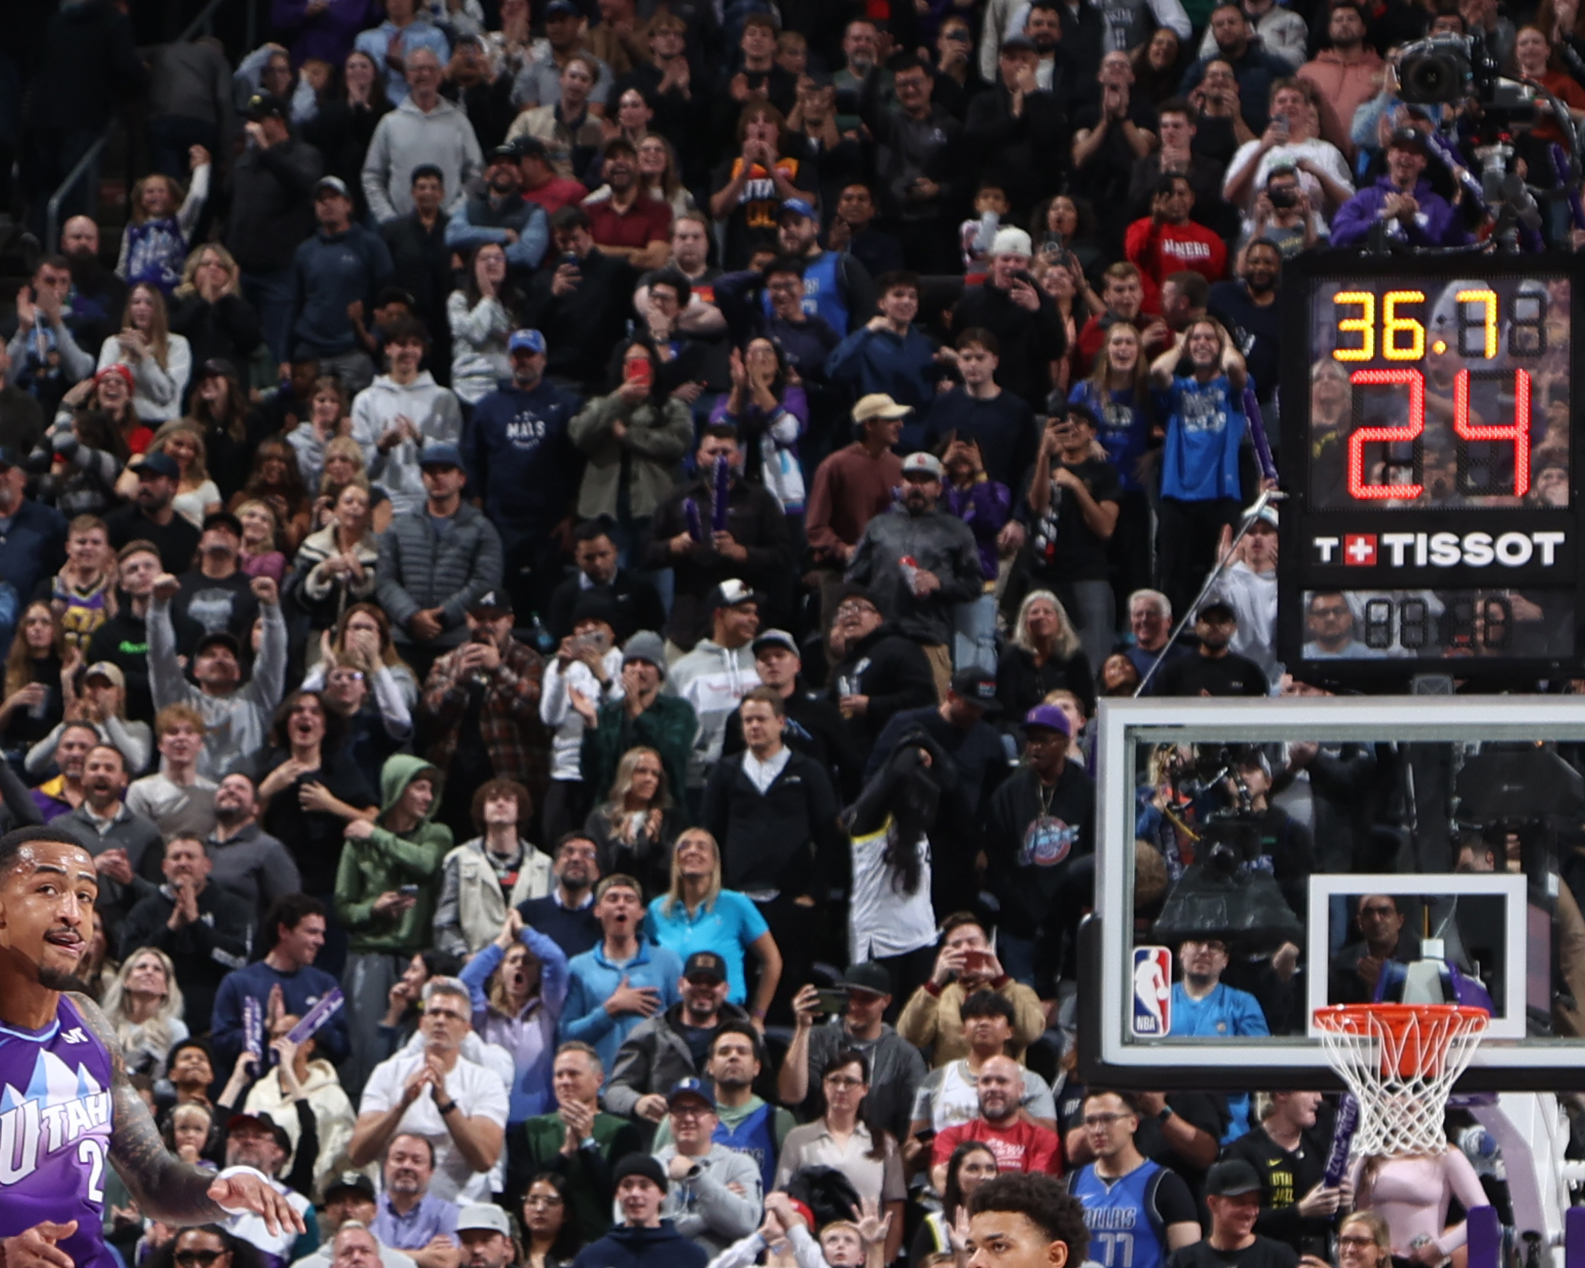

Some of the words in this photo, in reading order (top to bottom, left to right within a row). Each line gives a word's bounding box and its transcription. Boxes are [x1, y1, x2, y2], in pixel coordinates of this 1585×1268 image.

[1333, 290, 1498, 361] 36.7
[1348, 368, 1532, 499] 24
[1382, 532, 1565, 566] TISSOT
[1135, 1014, 1156, 1031] NBA
[1098, 1232, 1134, 1268] 77
